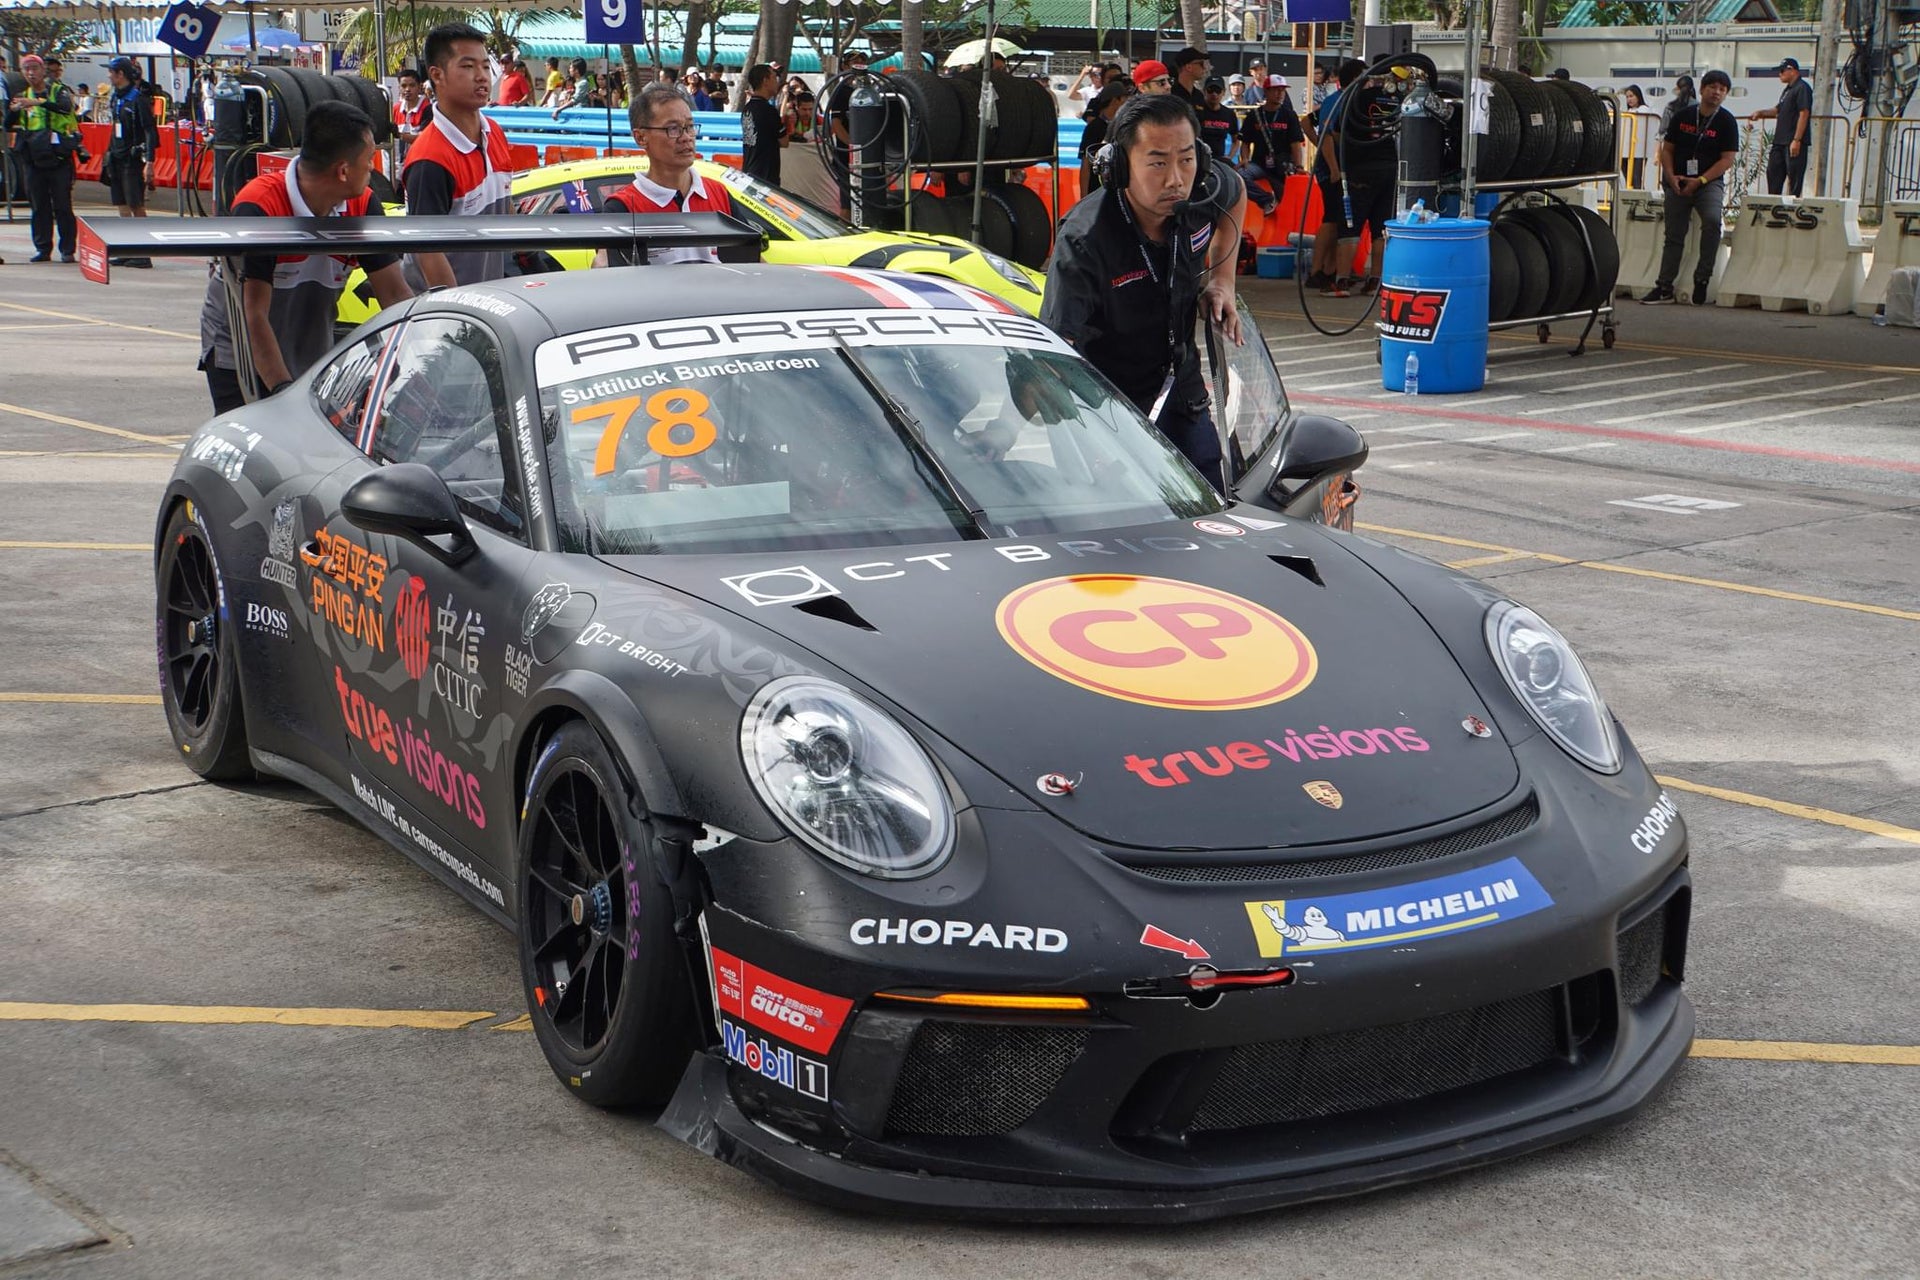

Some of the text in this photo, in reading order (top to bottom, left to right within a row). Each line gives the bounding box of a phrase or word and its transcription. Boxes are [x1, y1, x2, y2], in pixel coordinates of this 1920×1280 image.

[174, 12, 203, 42] 8
[601, 0, 627, 28] 9
[1747, 203, 1823, 231] TSS
[566, 314, 1054, 365] PORSCHE
[1396, 326, 1430, 337] FUELS
[560, 357, 820, 405] Suttiluck Buncharoen
[571, 387, 717, 477] 78
[515, 395, 542, 520] www.porsche.com
[261, 557, 297, 589] HUNTER
[246, 602, 288, 631] BOSS
[437, 593, 486, 675] 中信
[1048, 601, 1253, 668] CP
[504, 643, 533, 678] BLACK
[618, 640, 688, 678] BRIGHT
[435, 662, 483, 719] CITIC
[505, 666, 529, 698] TIGER
[351, 773, 505, 907] Watch LIVE on carreracupasia.com
[1630, 790, 1678, 854] CHOPAR
[1346, 878, 1520, 934] MICHELIN
[849, 916, 1069, 953] CHOPARD
[754, 985, 784, 1002] sport
[722, 1019, 795, 1090] Mobil
